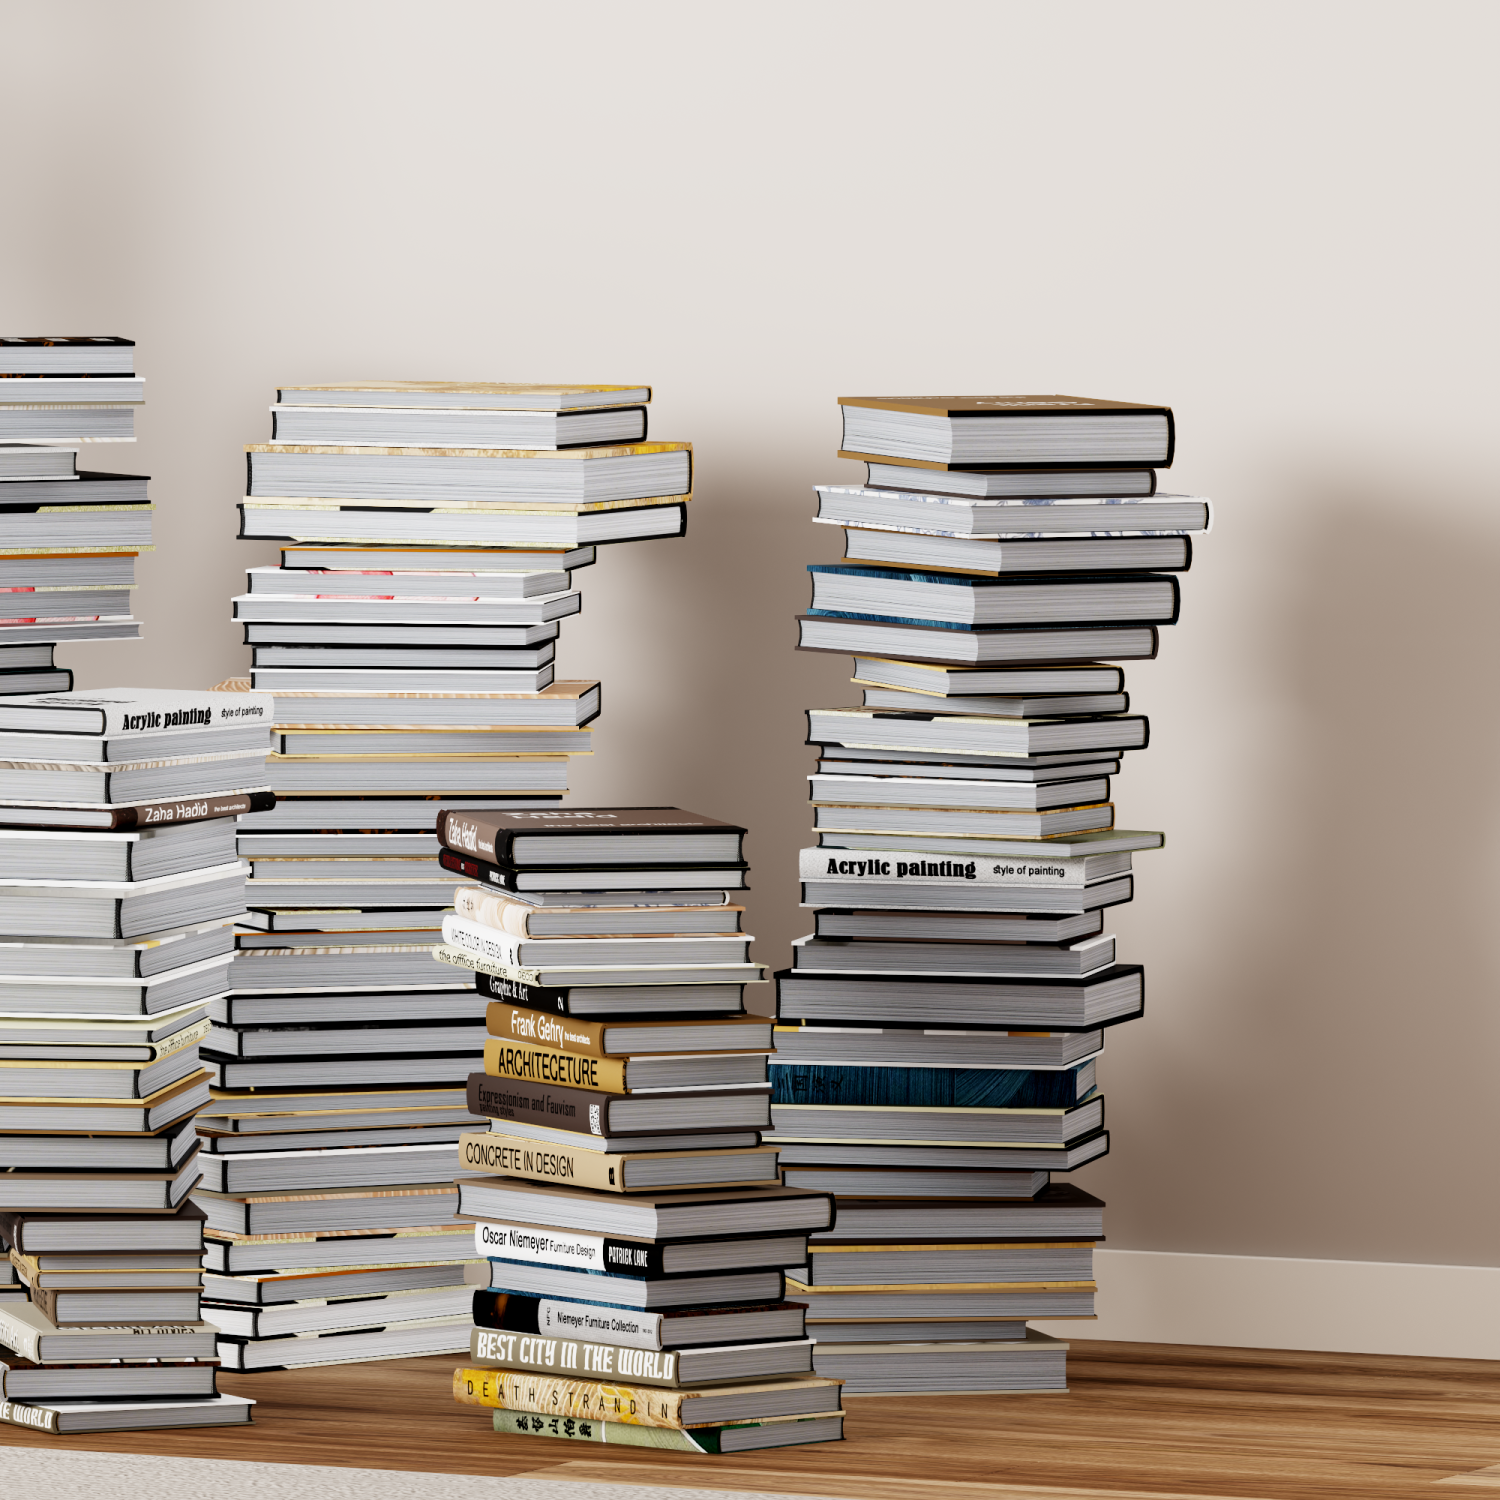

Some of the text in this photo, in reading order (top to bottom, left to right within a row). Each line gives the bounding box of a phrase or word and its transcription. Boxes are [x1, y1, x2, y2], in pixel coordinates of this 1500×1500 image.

[122, 707, 212, 731] Acrylic painting
[221, 706, 263, 719] style of painting
[145, 802, 208, 822] Zaha Hadid
[449, 818, 462, 847] Zaha
[462, 822, 477, 852] Hadid
[826, 858, 977, 879] Acrylic painting
[993, 863, 1065, 877] style of painting
[439, 949, 451, 963] the
[476, 957, 508, 977] furniture
[490, 976, 529, 1001] Graphic & Art
[511, 1010, 564, 1048] Frank Gehry
[499, 1047, 599, 1087] ARCHITECETURE
[479, 1084, 576, 1118] Expressionism and Fauvism
[466, 1142, 574, 1178] CONCRETE IN DESIGN
[482, 1226, 596, 1260] Oscar Niemeyer Furniture Design
[608, 1246, 648, 1268] PATRICK LANE
[557, 1311, 584, 1328] Niemeyer
[585, 1315, 610, 1331] Furniture
[611, 1319, 639, 1334] Collection
[477, 1332, 674, 1381] BEST CITY IN THE WORLD
[467, 1380, 535, 1403] DEATH
[13, 1404, 53, 1429] WORLD
